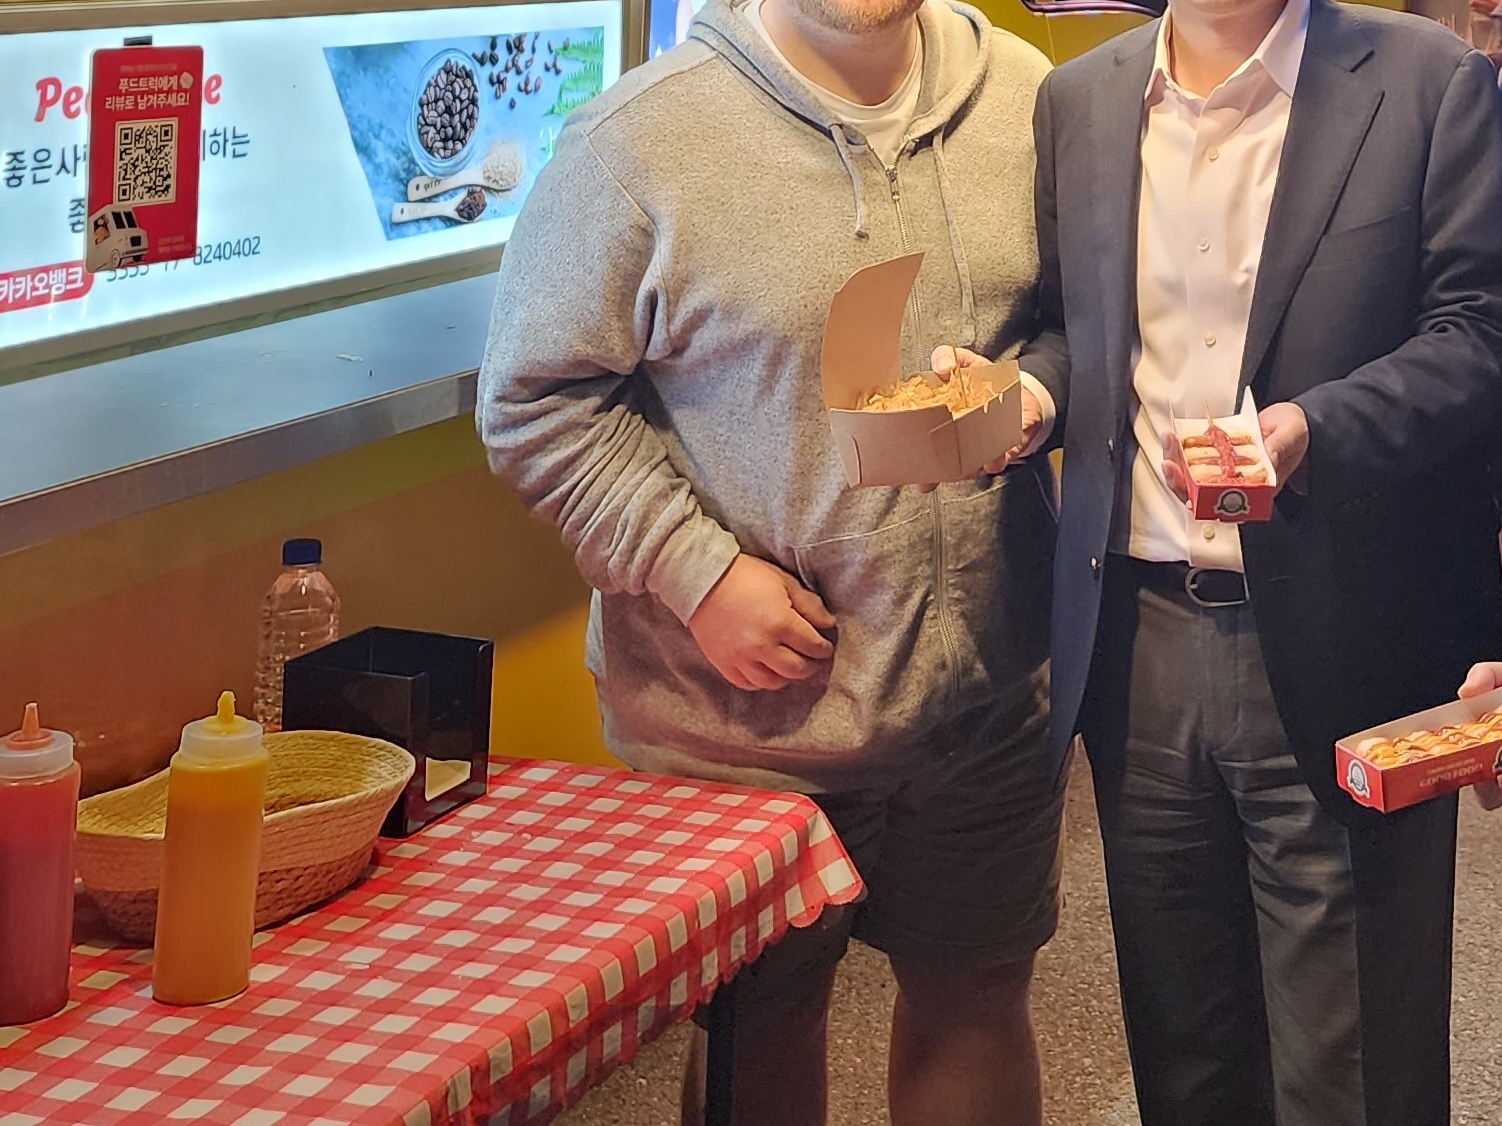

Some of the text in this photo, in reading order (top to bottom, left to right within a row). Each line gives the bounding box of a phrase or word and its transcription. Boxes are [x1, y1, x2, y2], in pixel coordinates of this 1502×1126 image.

[118, 74, 179, 94] 푸드트럭에게
[105, 95, 135, 112] 리뷰로
[3, 125, 250, 188] 좋은사 하는
[0, 266, 84, 304] 카카오뱅크
